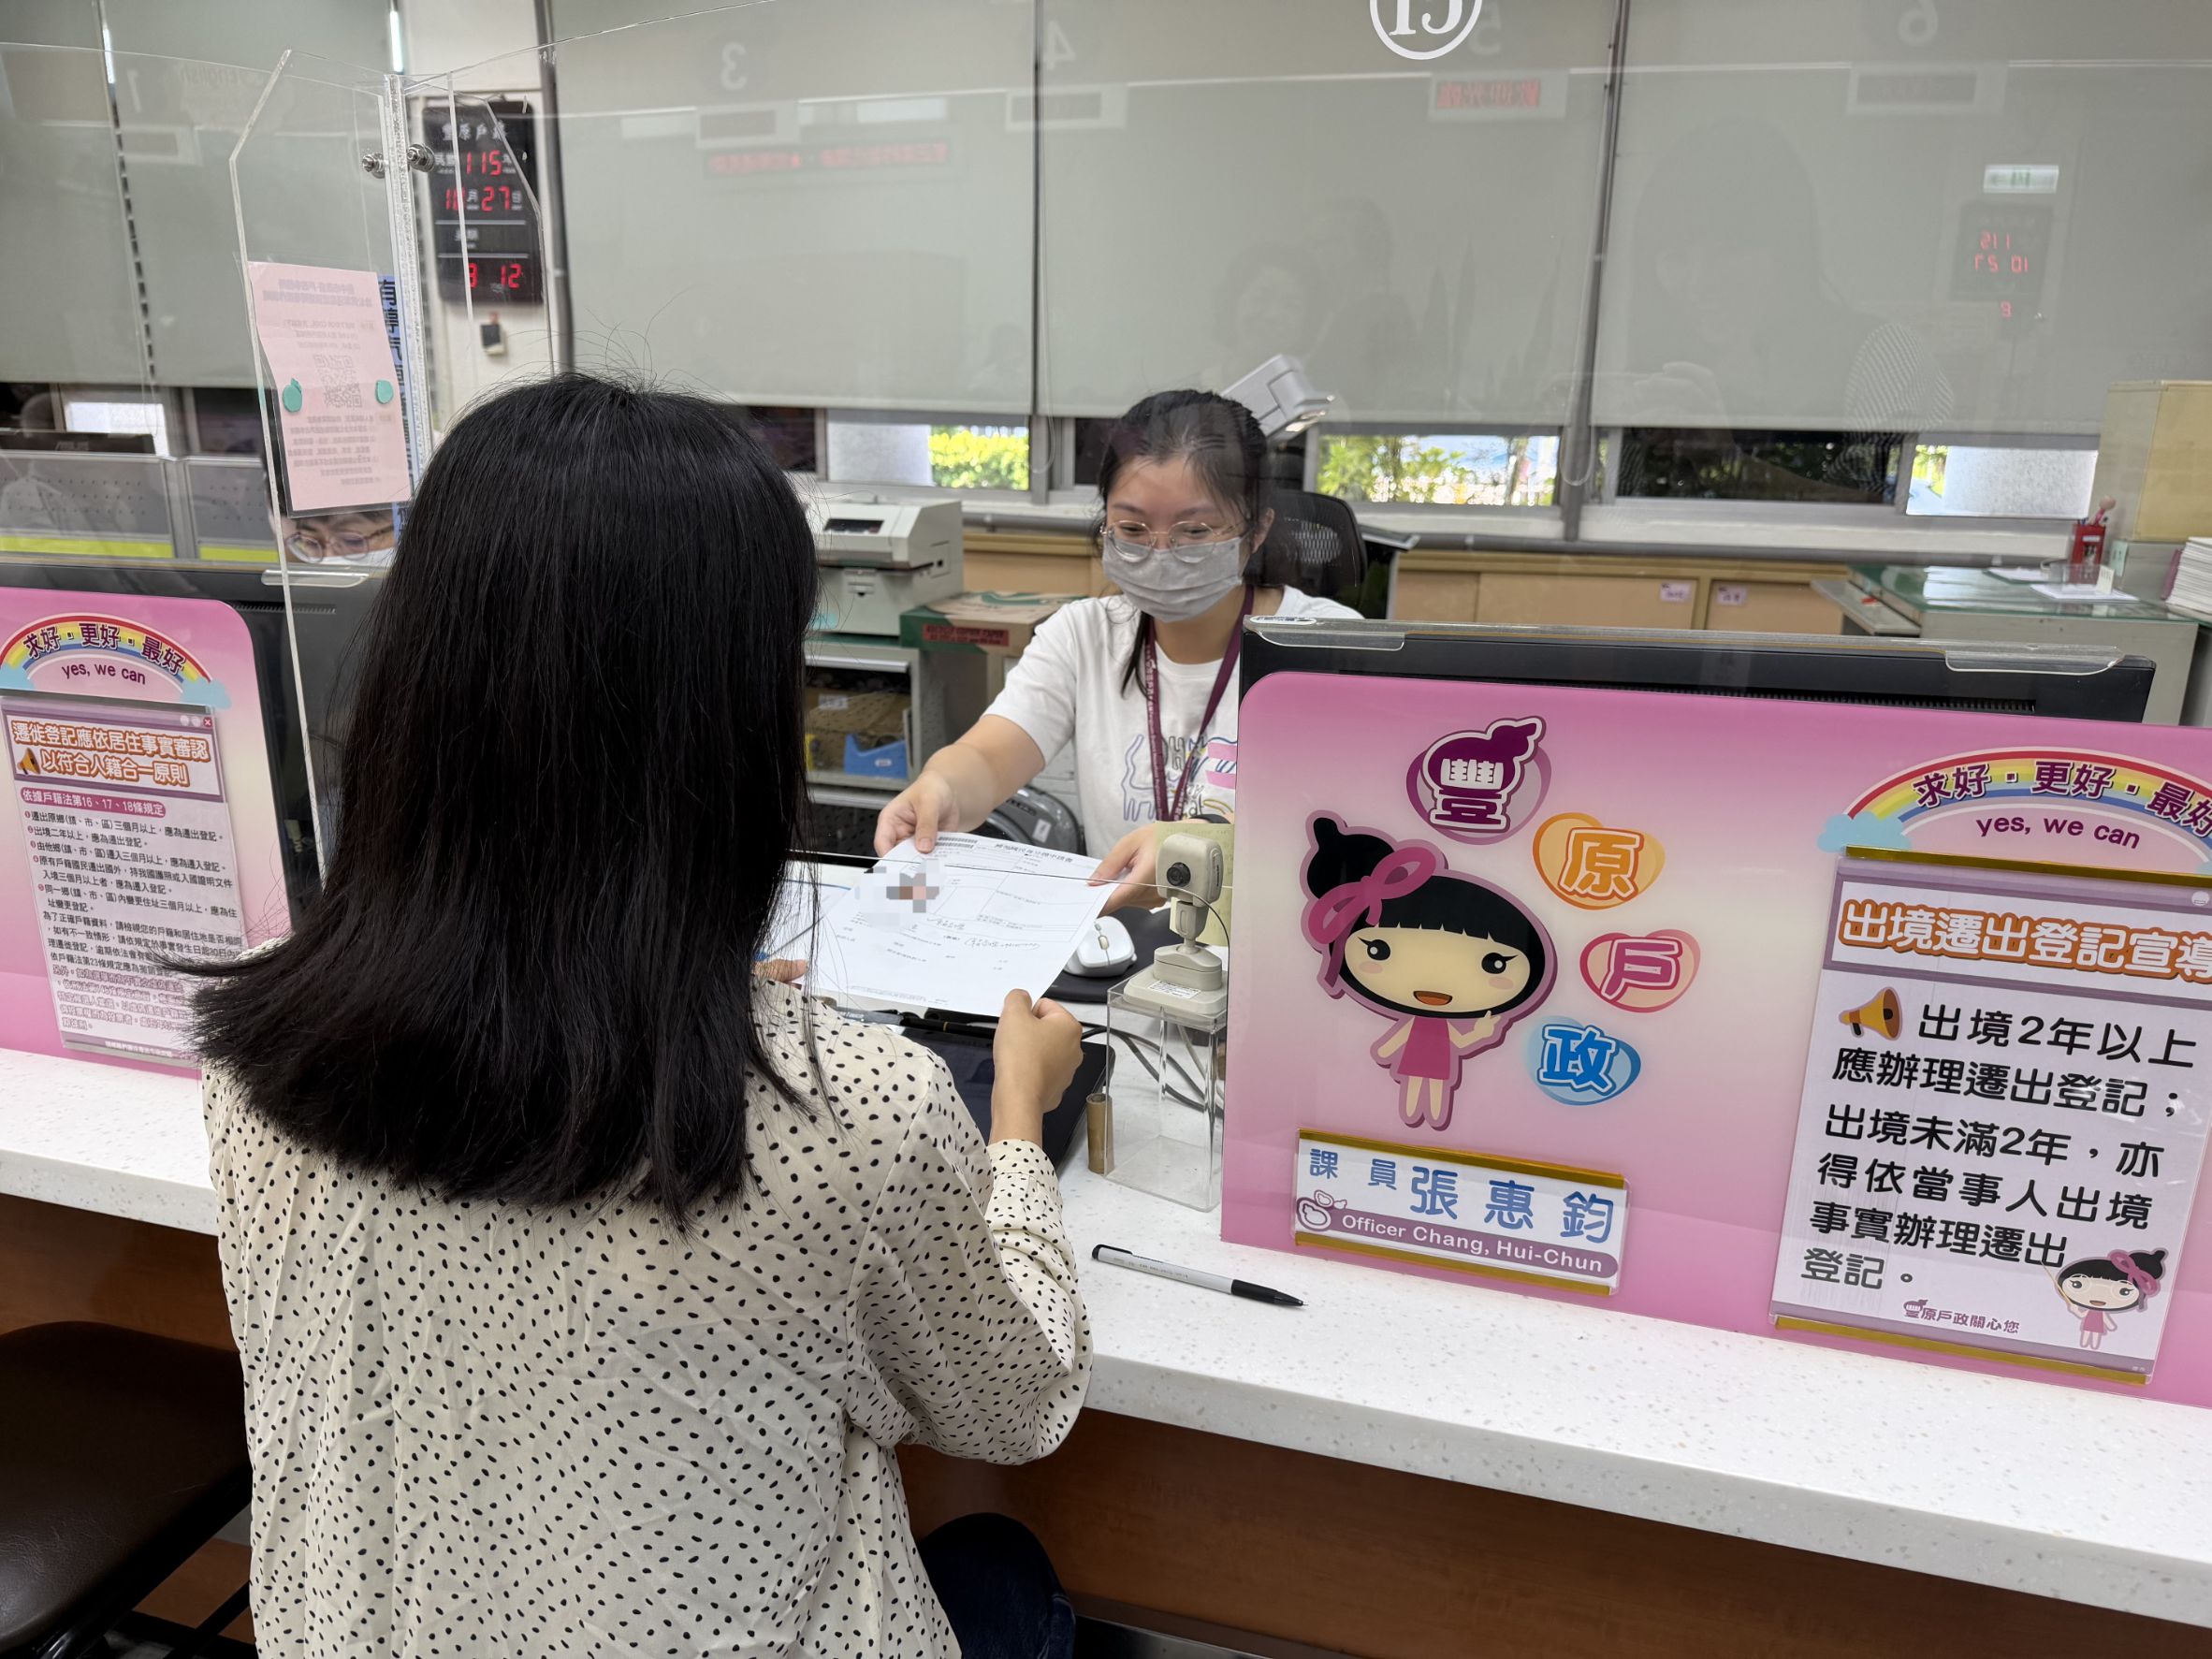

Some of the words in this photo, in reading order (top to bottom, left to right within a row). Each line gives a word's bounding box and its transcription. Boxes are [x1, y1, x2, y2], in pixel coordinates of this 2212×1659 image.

[466, 148, 503, 177] 115
[481, 185, 511, 212] 27
[500, 262, 523, 289] 12
[62, 663, 91, 680] yes,
[94, 662, 117, 677] we
[121, 667, 146, 686] can
[11, 720, 211, 763] 遷徙登記應依居住事實審認
[40, 749, 191, 788] 以符合人籍合一原則
[1421, 716, 1546, 834] 豐
[1975, 816, 2031, 837] yes,
[2044, 817, 2085, 837] we
[2093, 823, 2140, 850] can
[1557, 826, 1645, 902] 原
[1840, 899, 2212, 985] 出境遷出登記宣導
[1599, 937, 1683, 1001] 戶
[1536, 1024, 1621, 1097] 政
[1918, 1003, 2197, 1069] 出境2年以上
[1817, 1152, 2153, 1230] 得依當事人出境
[1342, 1215, 1406, 1239] Officer
[1413, 1225, 1491, 1256] Chang,
[1497, 1236, 1602, 1273] Hui-Chun
[1810, 1201, 2068, 1269] 事實辦理遷出
[1800, 1247, 1914, 1291] 登記。
[1903, 1299, 2020, 1334] 豐原戶政關心您
